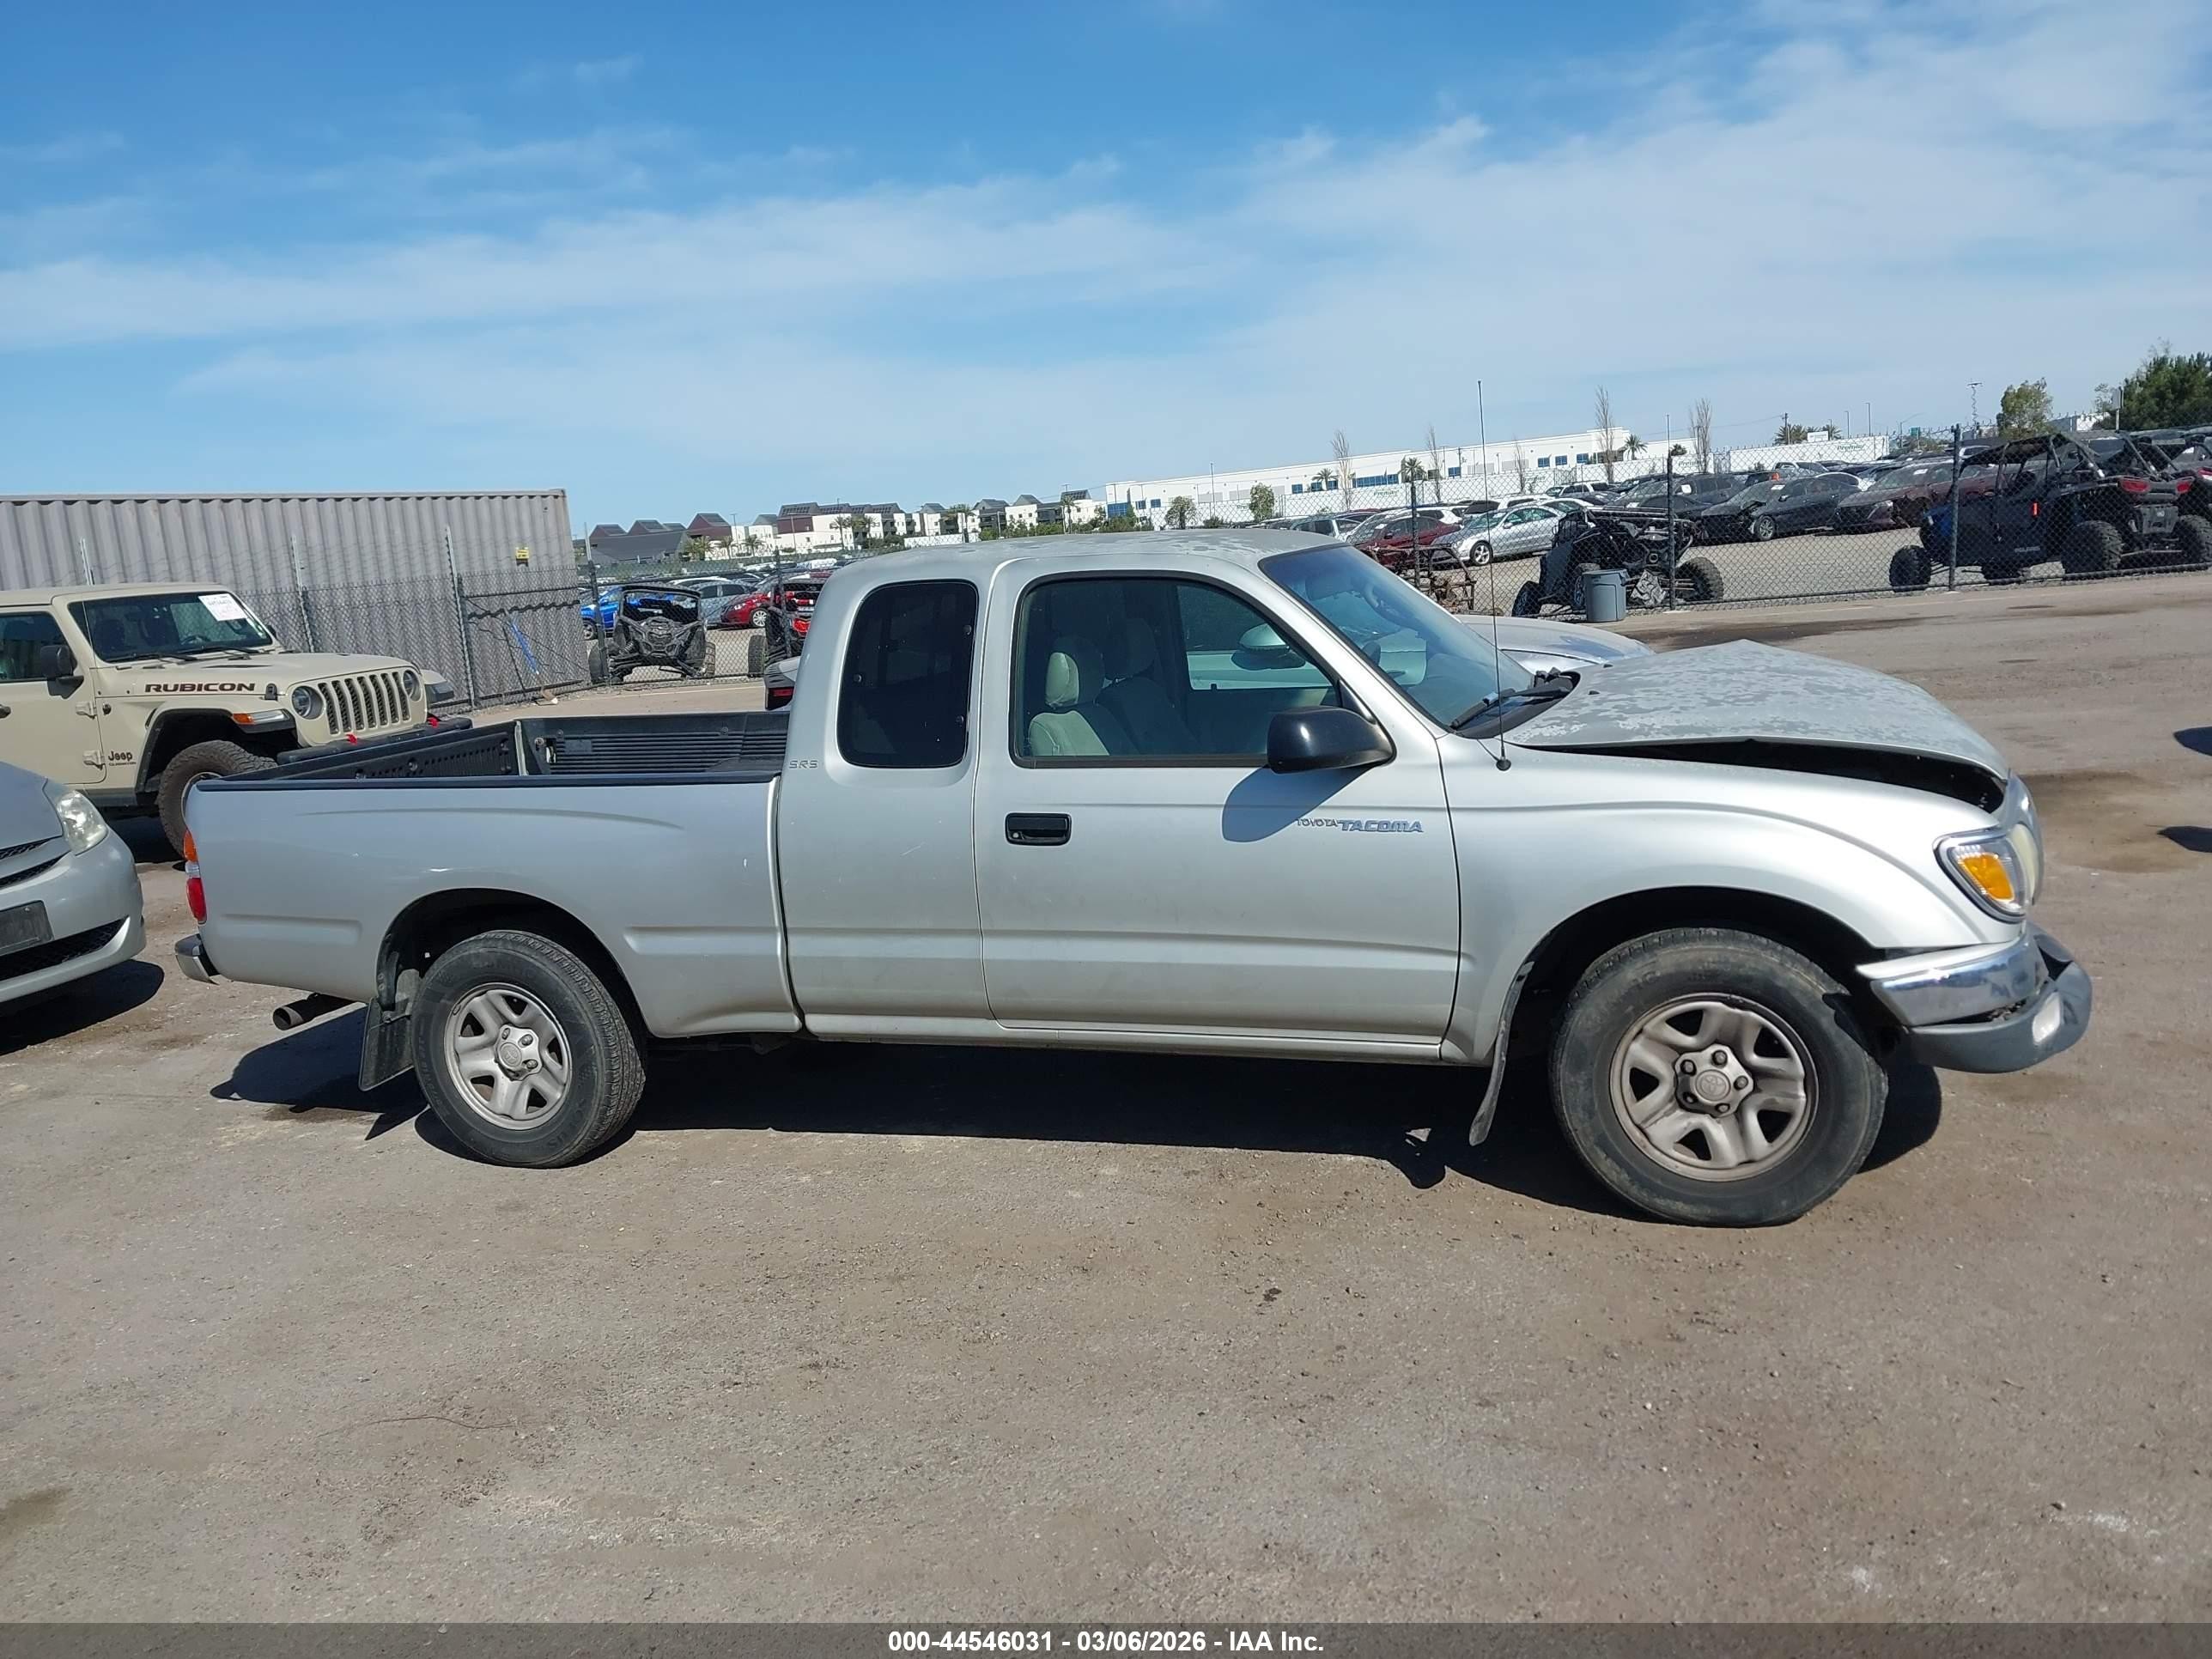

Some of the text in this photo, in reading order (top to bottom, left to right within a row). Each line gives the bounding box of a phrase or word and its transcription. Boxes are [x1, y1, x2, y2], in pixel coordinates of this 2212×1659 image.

[144, 683, 256, 693] RUBICON
[108, 750, 133, 762] Jeep
[788, 760, 818, 769] SRS
[1297, 818, 1424, 833] TOYOTA TACOMA
